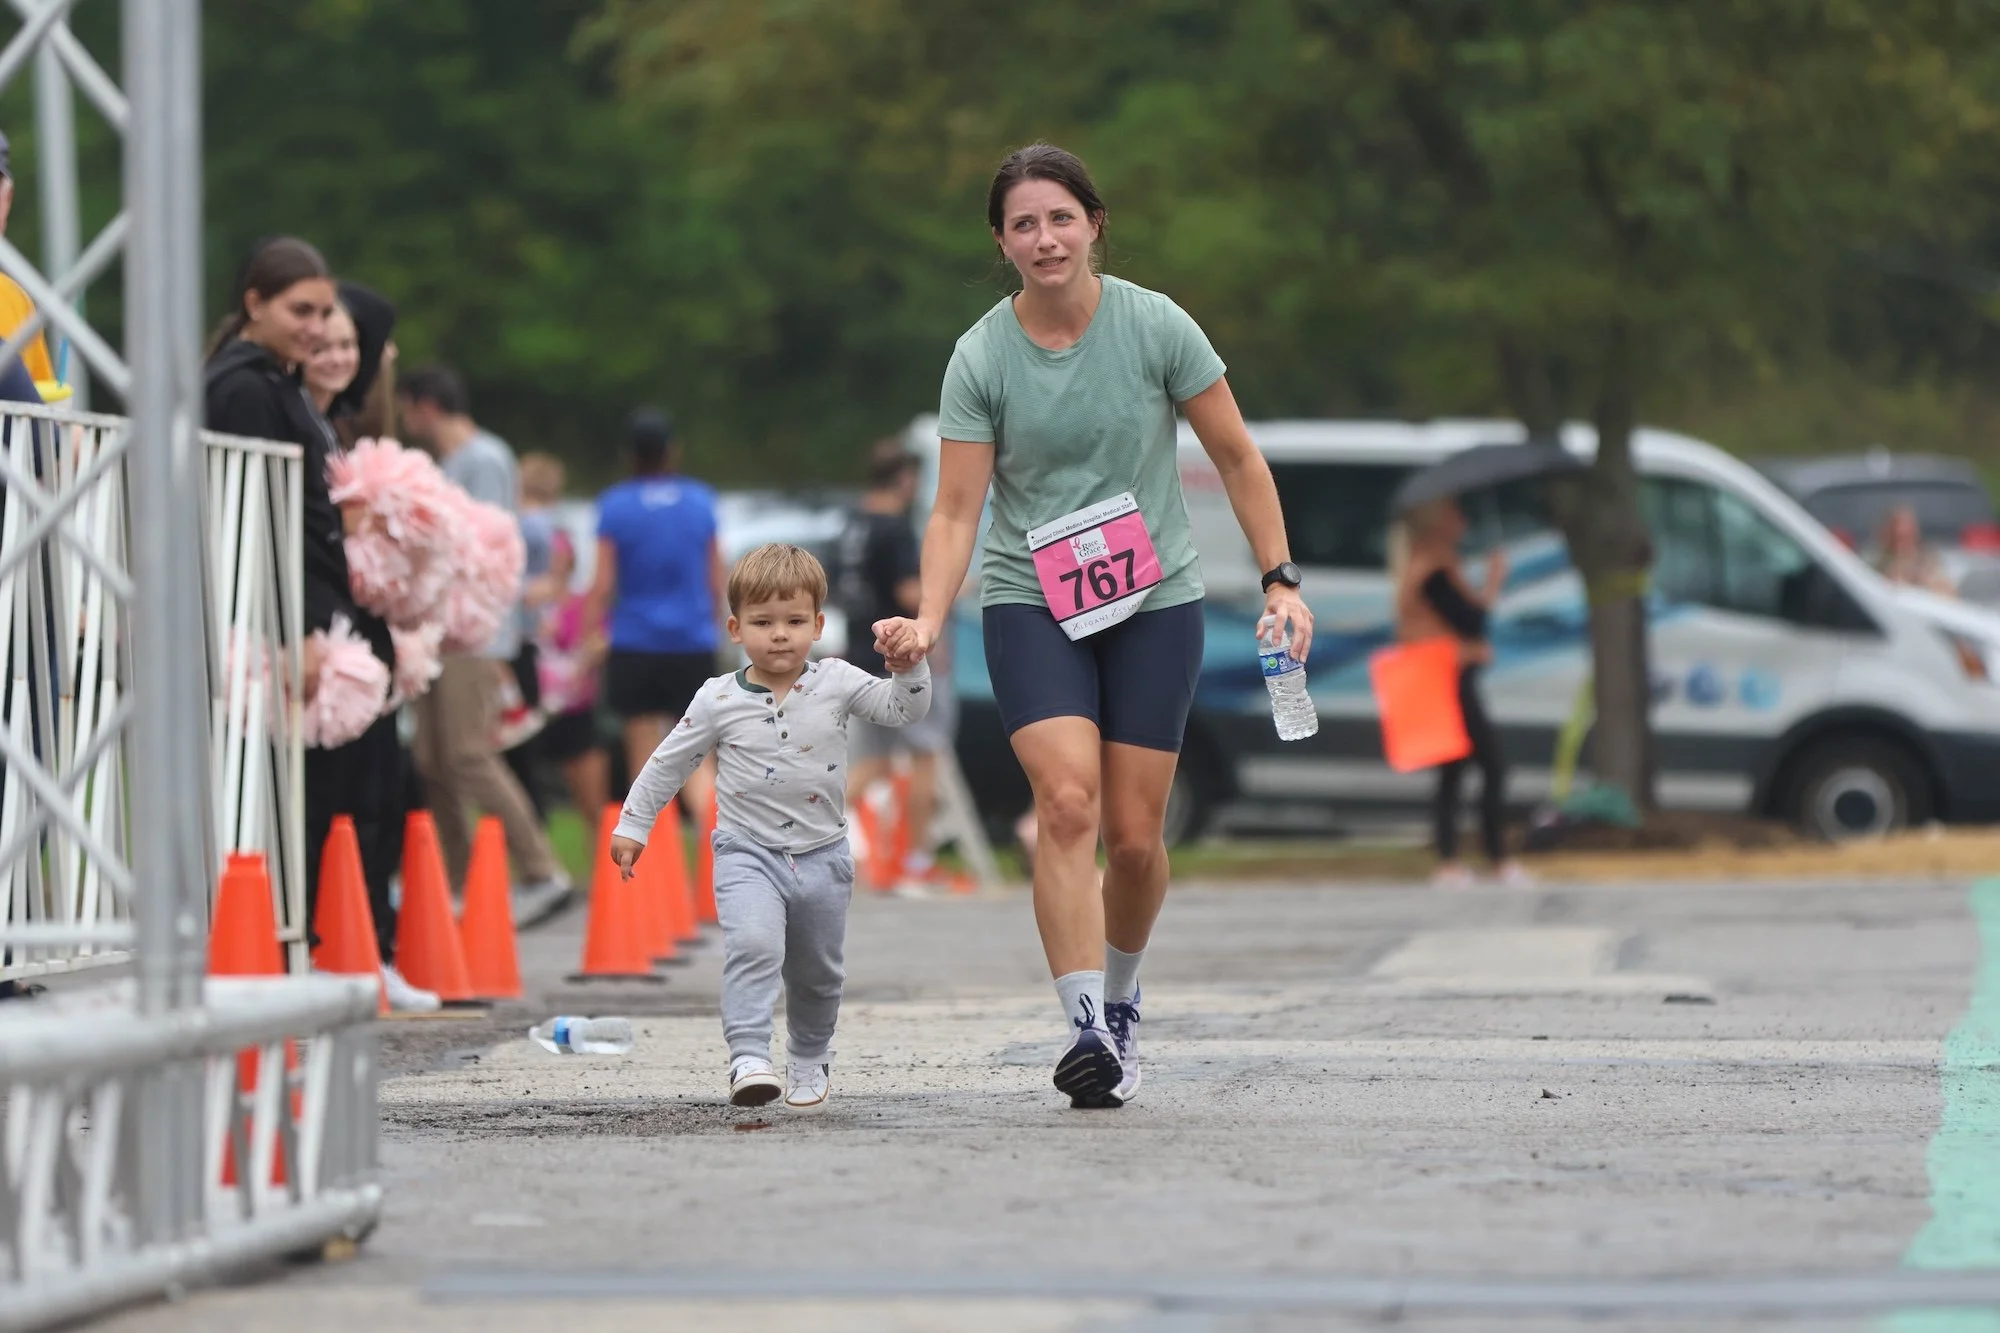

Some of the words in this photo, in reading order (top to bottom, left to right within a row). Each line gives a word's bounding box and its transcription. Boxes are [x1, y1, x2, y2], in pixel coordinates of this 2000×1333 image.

[1033, 533, 1052, 546] Cleveland
[1052, 528, 1065, 537] Clinic
[1066, 522, 1083, 531] Medina
[1083, 514, 1102, 526] Hospital
[1103, 507, 1120, 516] Medical
[1122, 502, 1133, 510] Staff
[1079, 546, 1100, 557] Grace
[1082, 540, 1098, 551] Race
[1059, 548, 1136, 611] 767
